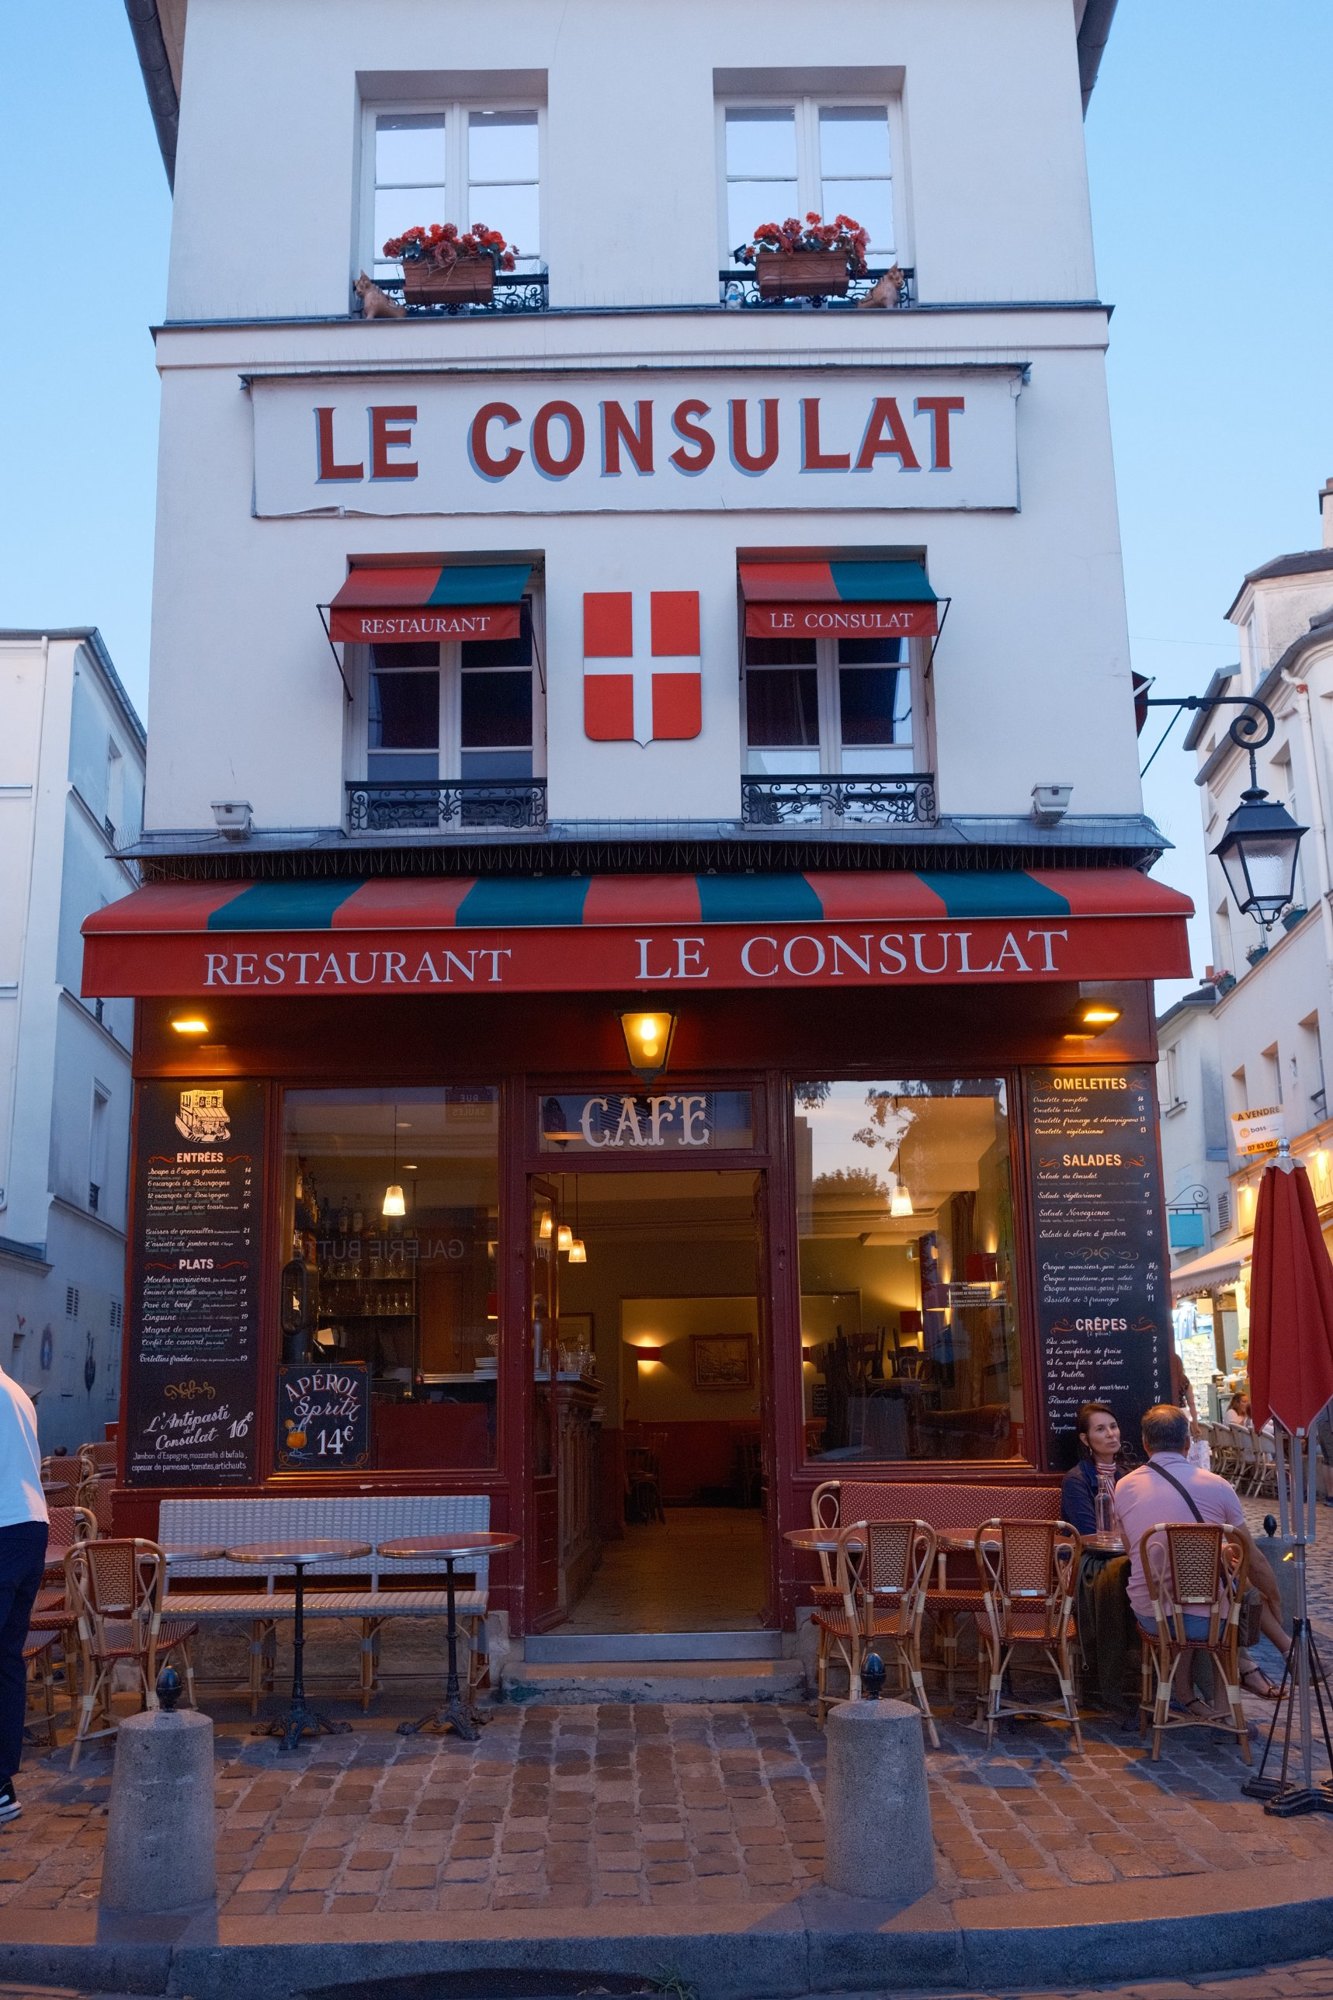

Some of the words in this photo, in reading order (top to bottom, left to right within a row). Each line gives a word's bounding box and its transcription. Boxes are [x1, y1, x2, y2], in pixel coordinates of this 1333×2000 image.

[315, 405, 419, 482] LE
[468, 396, 966, 479] CONSULAT
[360, 616, 491, 636] RESTAURANT
[770, 612, 796, 630] LE
[804, 611, 914, 629] CONSULAT
[203, 948, 512, 986] RESTAURANT
[634, 937, 710, 979] LE
[741, 929, 1068, 977] CONSULAT
[1053, 1077, 1127, 1090] OMELETTES
[1033, 1096, 1060, 1104] Omelette
[1237, 1113, 1244, 1121] A
[1245, 1106, 1280, 1119] VENDRE
[1100, 1116, 1139, 1127] champignons
[1062, 1154, 1122, 1167] SALADES
[148, 1167, 169, 1176] Soupe
[153, 1180, 180, 1188] escargots
[193, 1178, 231, 1188] Bourgogne
[154, 1192, 182, 1200] escargots
[194, 1191, 229, 1200] Bourgogne
[1038, 1191, 1060, 1199] Salade
[1038, 1209, 1063, 1217] Salade
[179, 1227, 214, 1236] grenouilles
[1039, 1229, 1062, 1238] Salade
[1063, 1229, 1071, 1237] de
[1101, 1228, 1127, 1241] jambon
[145, 1239, 175, 1248] L'assiette
[186, 1240, 208, 1248] jambon
[179, 1259, 214, 1270] PLATS
[1042, 1261, 1065, 1274] Croque
[143, 1275, 171, 1284] Moules
[1043, 1273, 1066, 1285] Croque
[168, 1287, 175, 1295] de
[1043, 1284, 1066, 1295] Croque
[143, 1301, 160, 1309] Pavé
[161, 1301, 170, 1309] de
[1044, 1295, 1071, 1303] Assiette
[1083, 1295, 1088, 1303] 3
[1088, 1295, 1120, 1307] fromages
[1147, 1294, 1154, 1302] 11
[142, 1313, 177, 1323] Linguine
[1075, 1317, 1128, 1331] CRÊPES
[142, 1325, 171, 1335] Magret
[173, 1325, 182, 1333] de
[184, 1325, 211, 1333] canard
[141, 1337, 162, 1348] Confit
[176, 1337, 204, 1345] canard
[1055, 1347, 1063, 1355] la
[1063, 1347, 1092, 1359] confiture
[1103, 1347, 1122, 1358] fraise
[1054, 1358, 1063, 1366] la
[1065, 1358, 1094, 1370] confiture
[1095, 1358, 1124, 1366] d'abricot
[1060, 1370, 1085, 1378] Nutella
[285, 1369, 358, 1402] APÉROL
[1057, 1382, 1065, 1391] la
[1088, 1383, 1097, 1391] de
[1154, 1395, 1160, 1403] 11
[293, 1395, 361, 1425] Spritz
[143, 1403, 230, 1434] L'Antipasti
[155, 1427, 219, 1450] Consulat
[317, 1425, 354, 1455] 14€
[132, 1451, 156, 1461] Jambon
[131, 1464, 153, 1474] copeaux
[153, 1463, 162, 1471] de
[214, 1460, 247, 1471] artichauts
